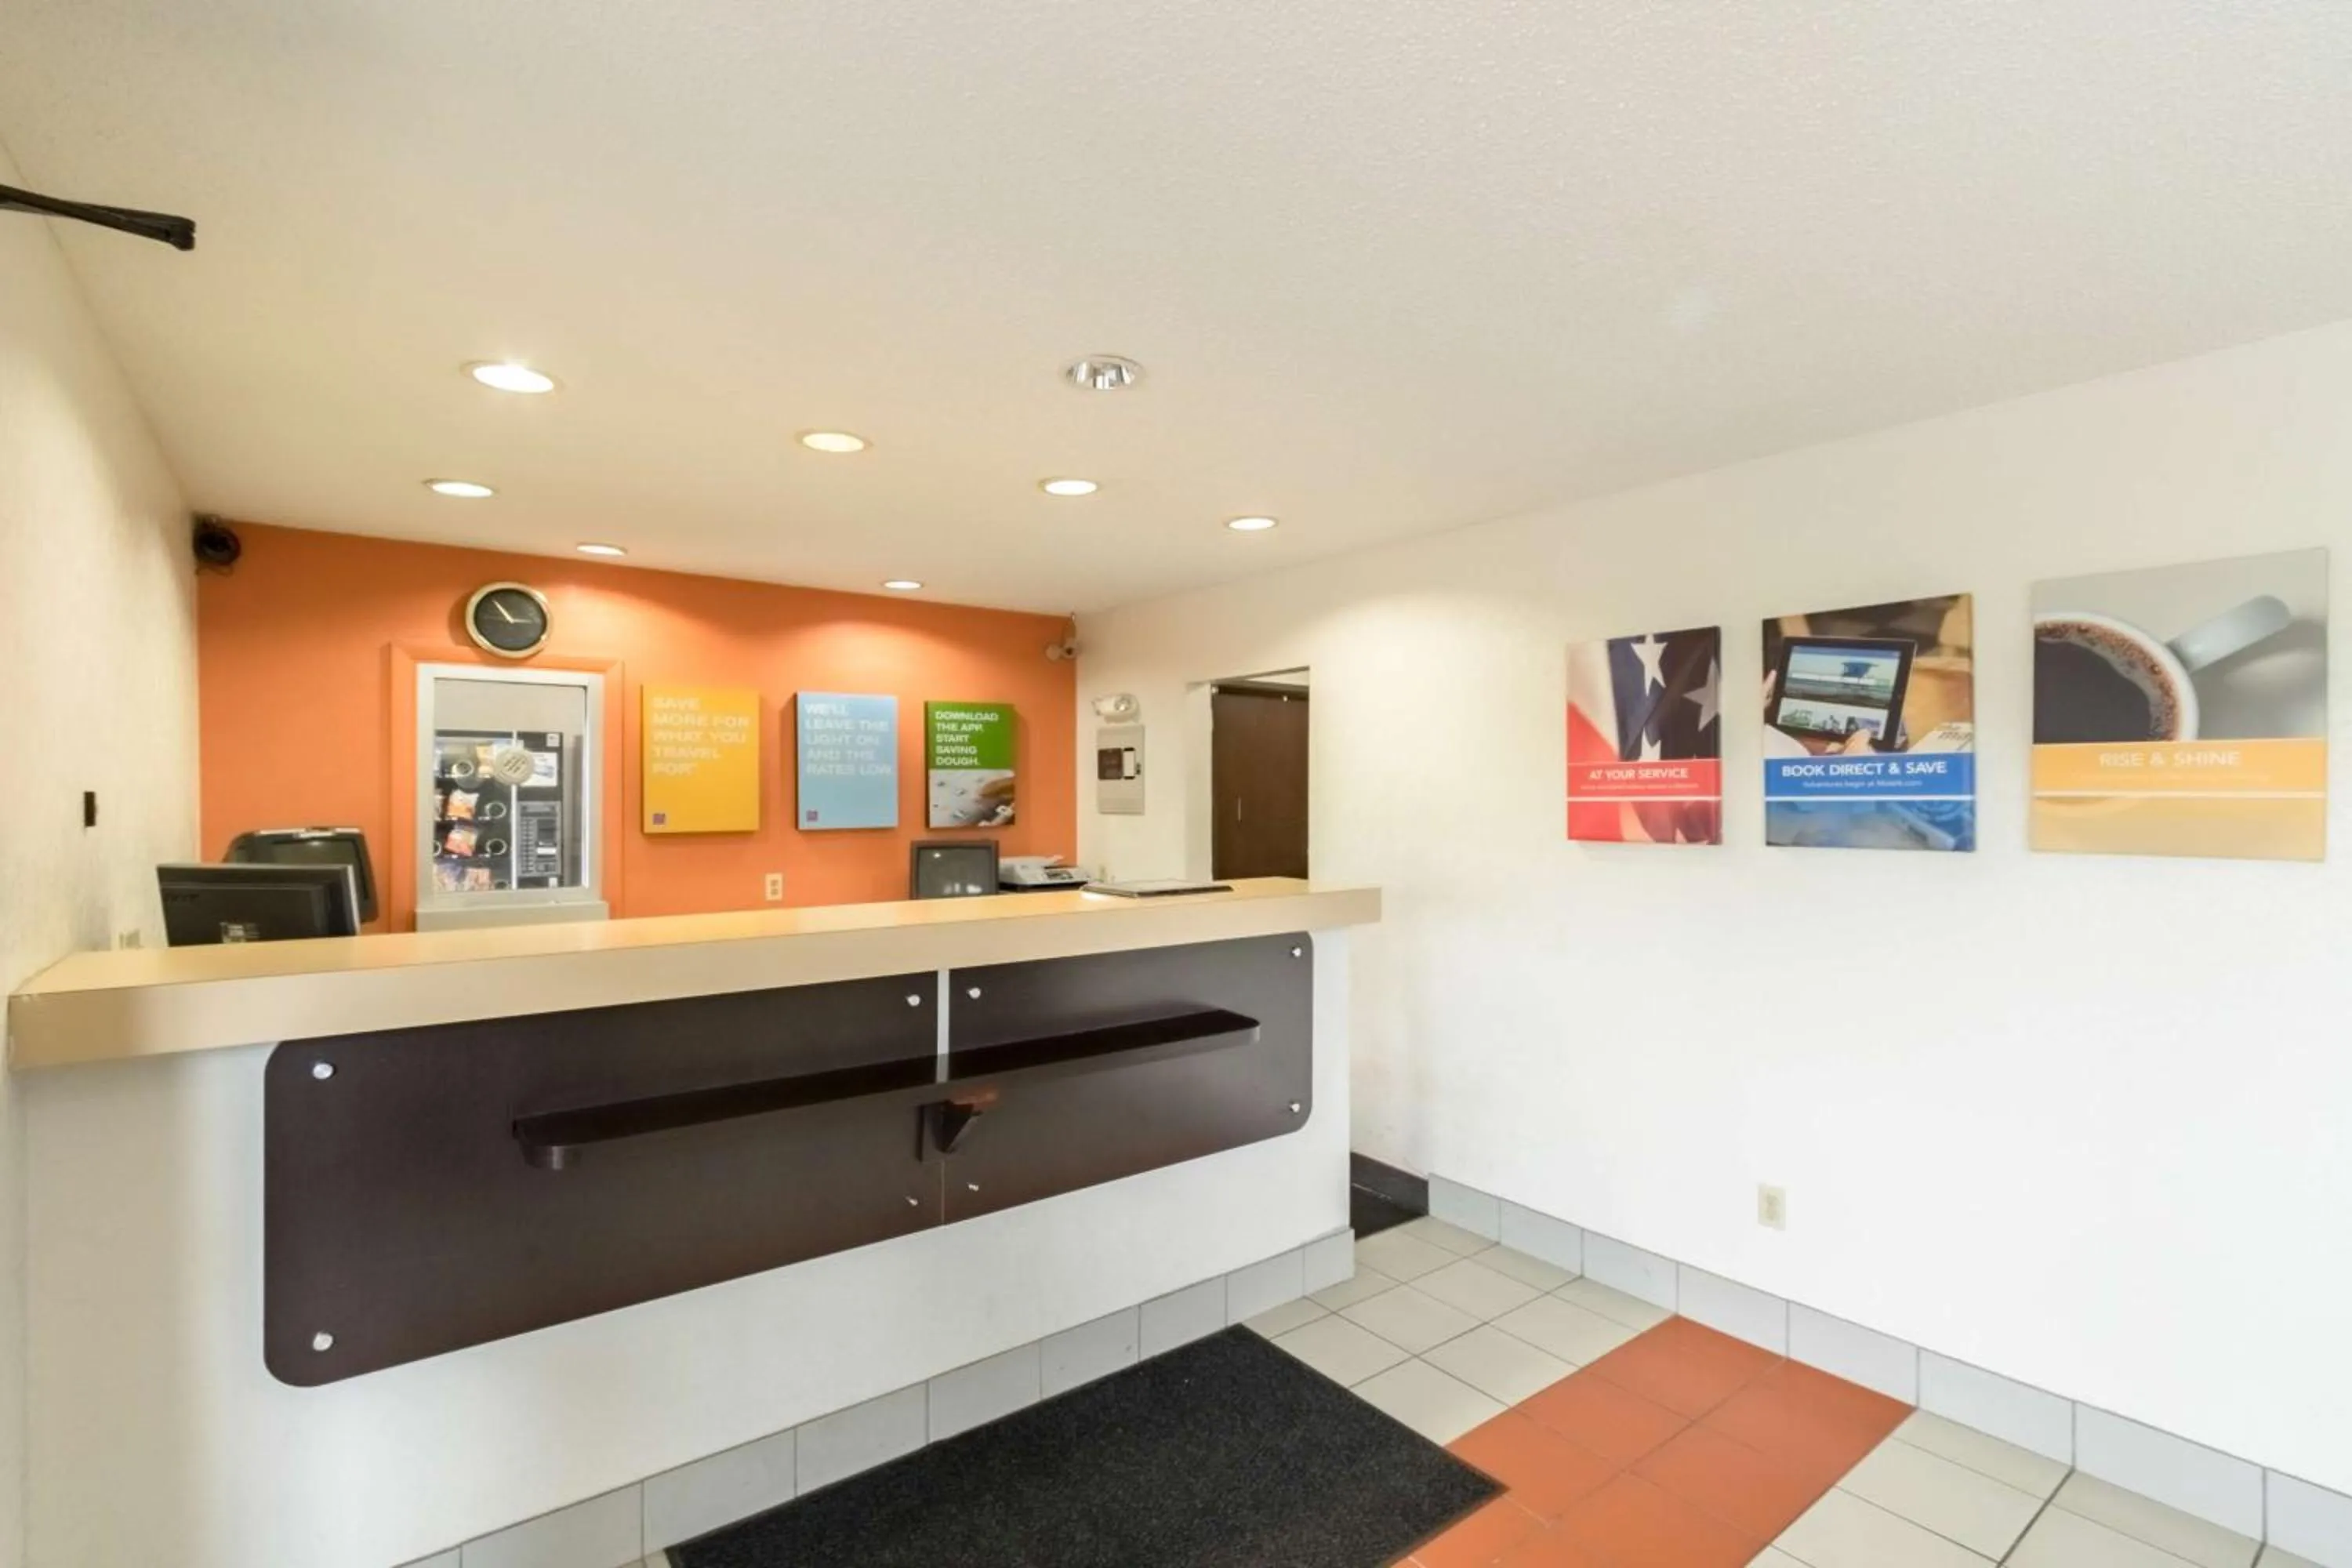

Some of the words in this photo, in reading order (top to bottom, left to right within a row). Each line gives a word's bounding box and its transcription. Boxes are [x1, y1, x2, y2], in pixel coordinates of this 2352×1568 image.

[652, 697, 700, 710] SAVE
[652, 713, 707, 726] MORE
[712, 716, 750, 728] FOR
[935, 710, 999, 721] DOWNLOAD
[804, 718, 855, 729] LEAVE
[858, 720, 889, 731] THE
[935, 722, 958, 731] THE
[652, 729, 703, 742] WHAT
[710, 731, 746, 743] YOU
[804, 733, 851, 746] LIGHT
[855, 735, 880, 746] ON
[935, 734, 969, 742] START
[652, 746, 721, 760] TRAVEL
[807, 748, 840, 760] AND
[846, 750, 874, 760] THE
[935, 746, 978, 754] SAVING
[935, 756, 981, 766] DOUGH.
[2099, 752, 2144, 768] RISE
[2150, 751, 2165, 767] &
[2173, 750, 2241, 767] SHINE
[806, 763, 855, 775] RATES
[1589, 768, 1603, 780] AT
[1606, 768, 1636, 781] YOUR
[1638, 767, 1689, 779] SERVICE
[1781, 764, 1825, 777] BOOK
[1829, 763, 1885, 776] DIRECT
[1888, 762, 1900, 775] &
[1905, 760, 1948, 775] SAVE
